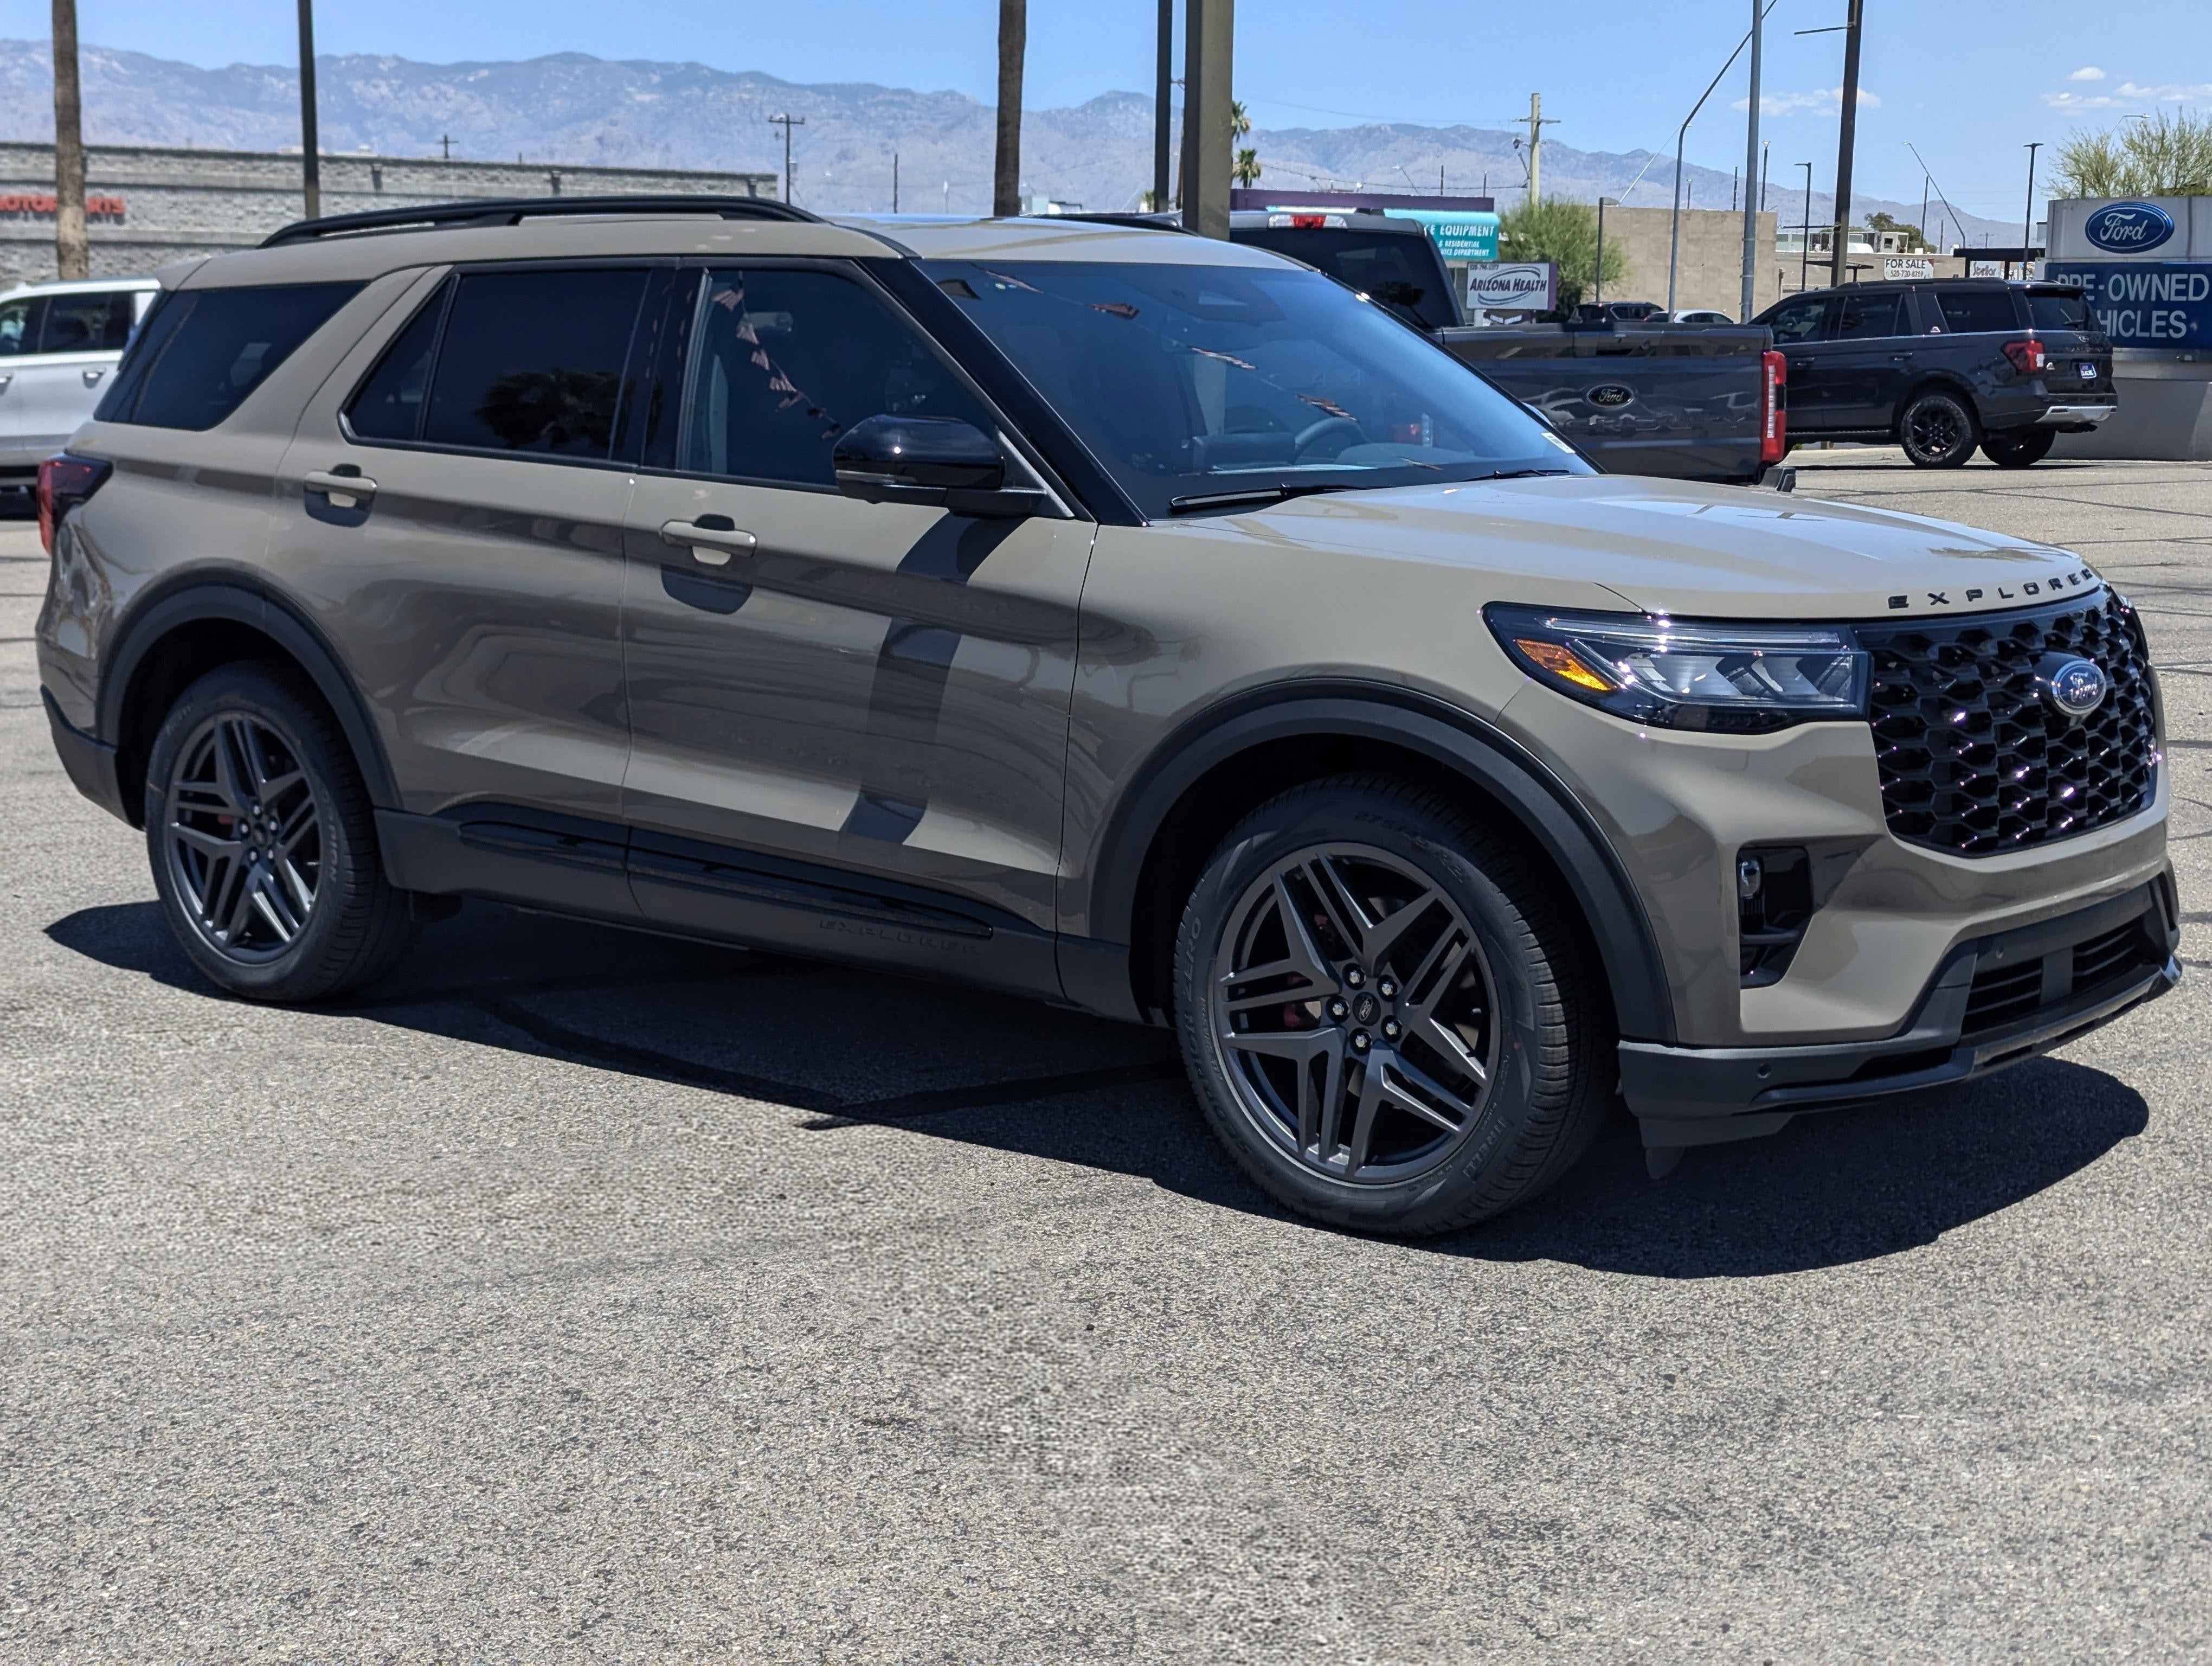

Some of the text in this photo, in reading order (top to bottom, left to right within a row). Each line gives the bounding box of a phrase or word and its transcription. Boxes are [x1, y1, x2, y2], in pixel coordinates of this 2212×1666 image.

[1439, 225, 1495, 237] EQUIPMENT
[2099, 212, 2149, 241] Ford
[1886, 259, 1926, 269] FOR SALE
[1470, 278, 1547, 292] ARIZONA HEALTH
[2097, 310, 2187, 338] HICLES
[1598, 388, 1624, 402] Ford
[1887, 568, 2093, 610] EXPLORER
[2069, 671, 2099, 703] Ford
[819, 918, 980, 956] EXPLORER
[1182, 915, 1202, 1003] ZERO
